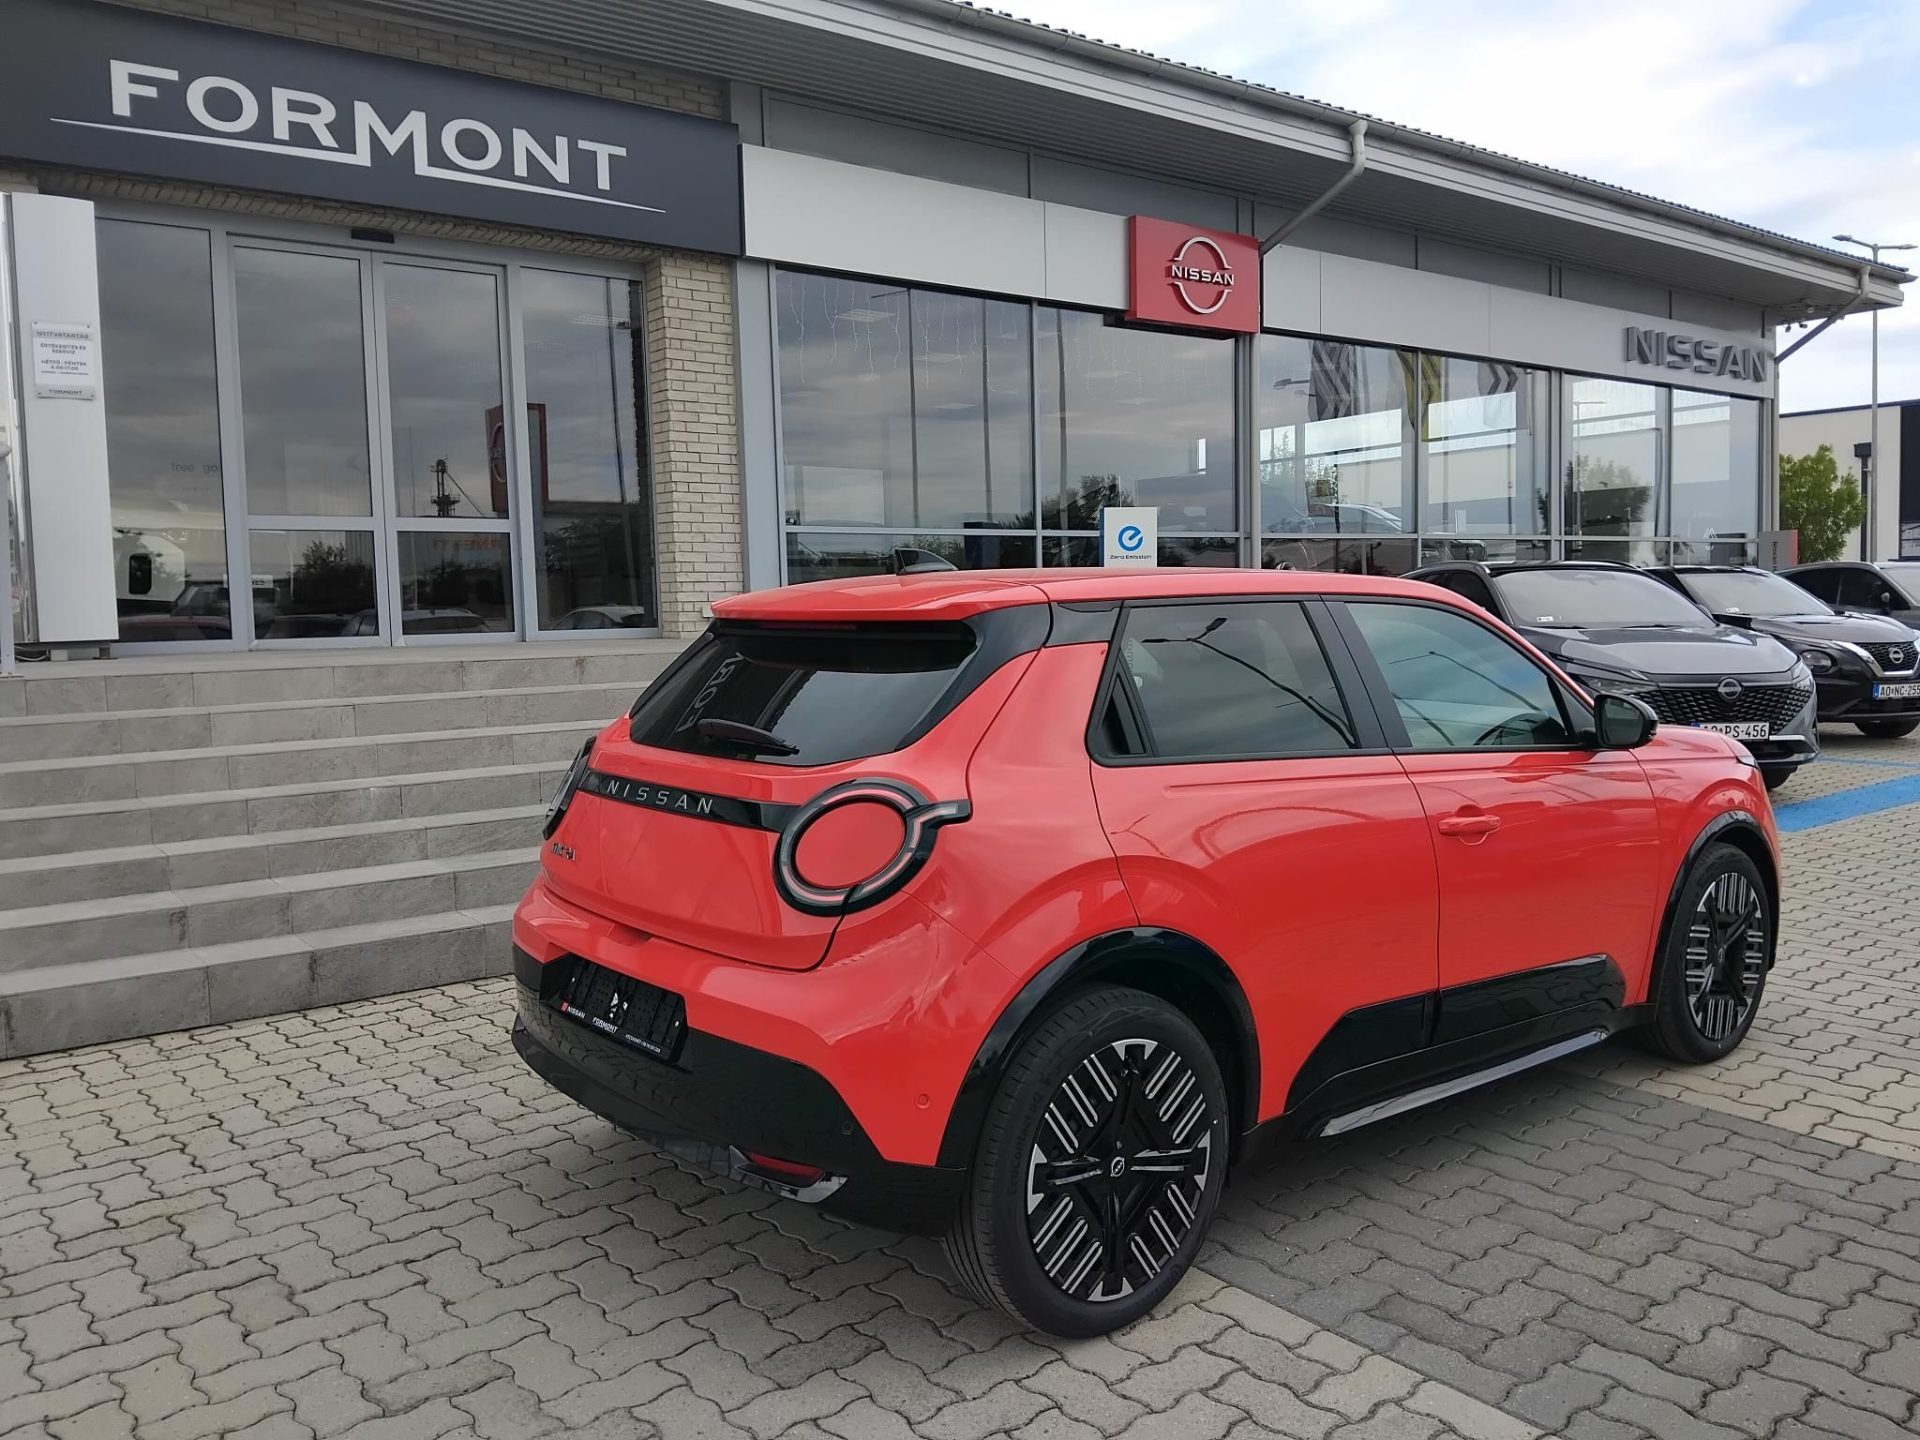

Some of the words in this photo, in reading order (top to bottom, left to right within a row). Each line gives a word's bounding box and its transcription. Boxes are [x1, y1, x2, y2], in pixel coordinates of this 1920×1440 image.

[109, 59, 627, 191] FORMONT
[1171, 264, 1235, 286] NISSAN
[1625, 326, 1768, 382] NISSAN
[606, 779, 713, 815] NISSAN
